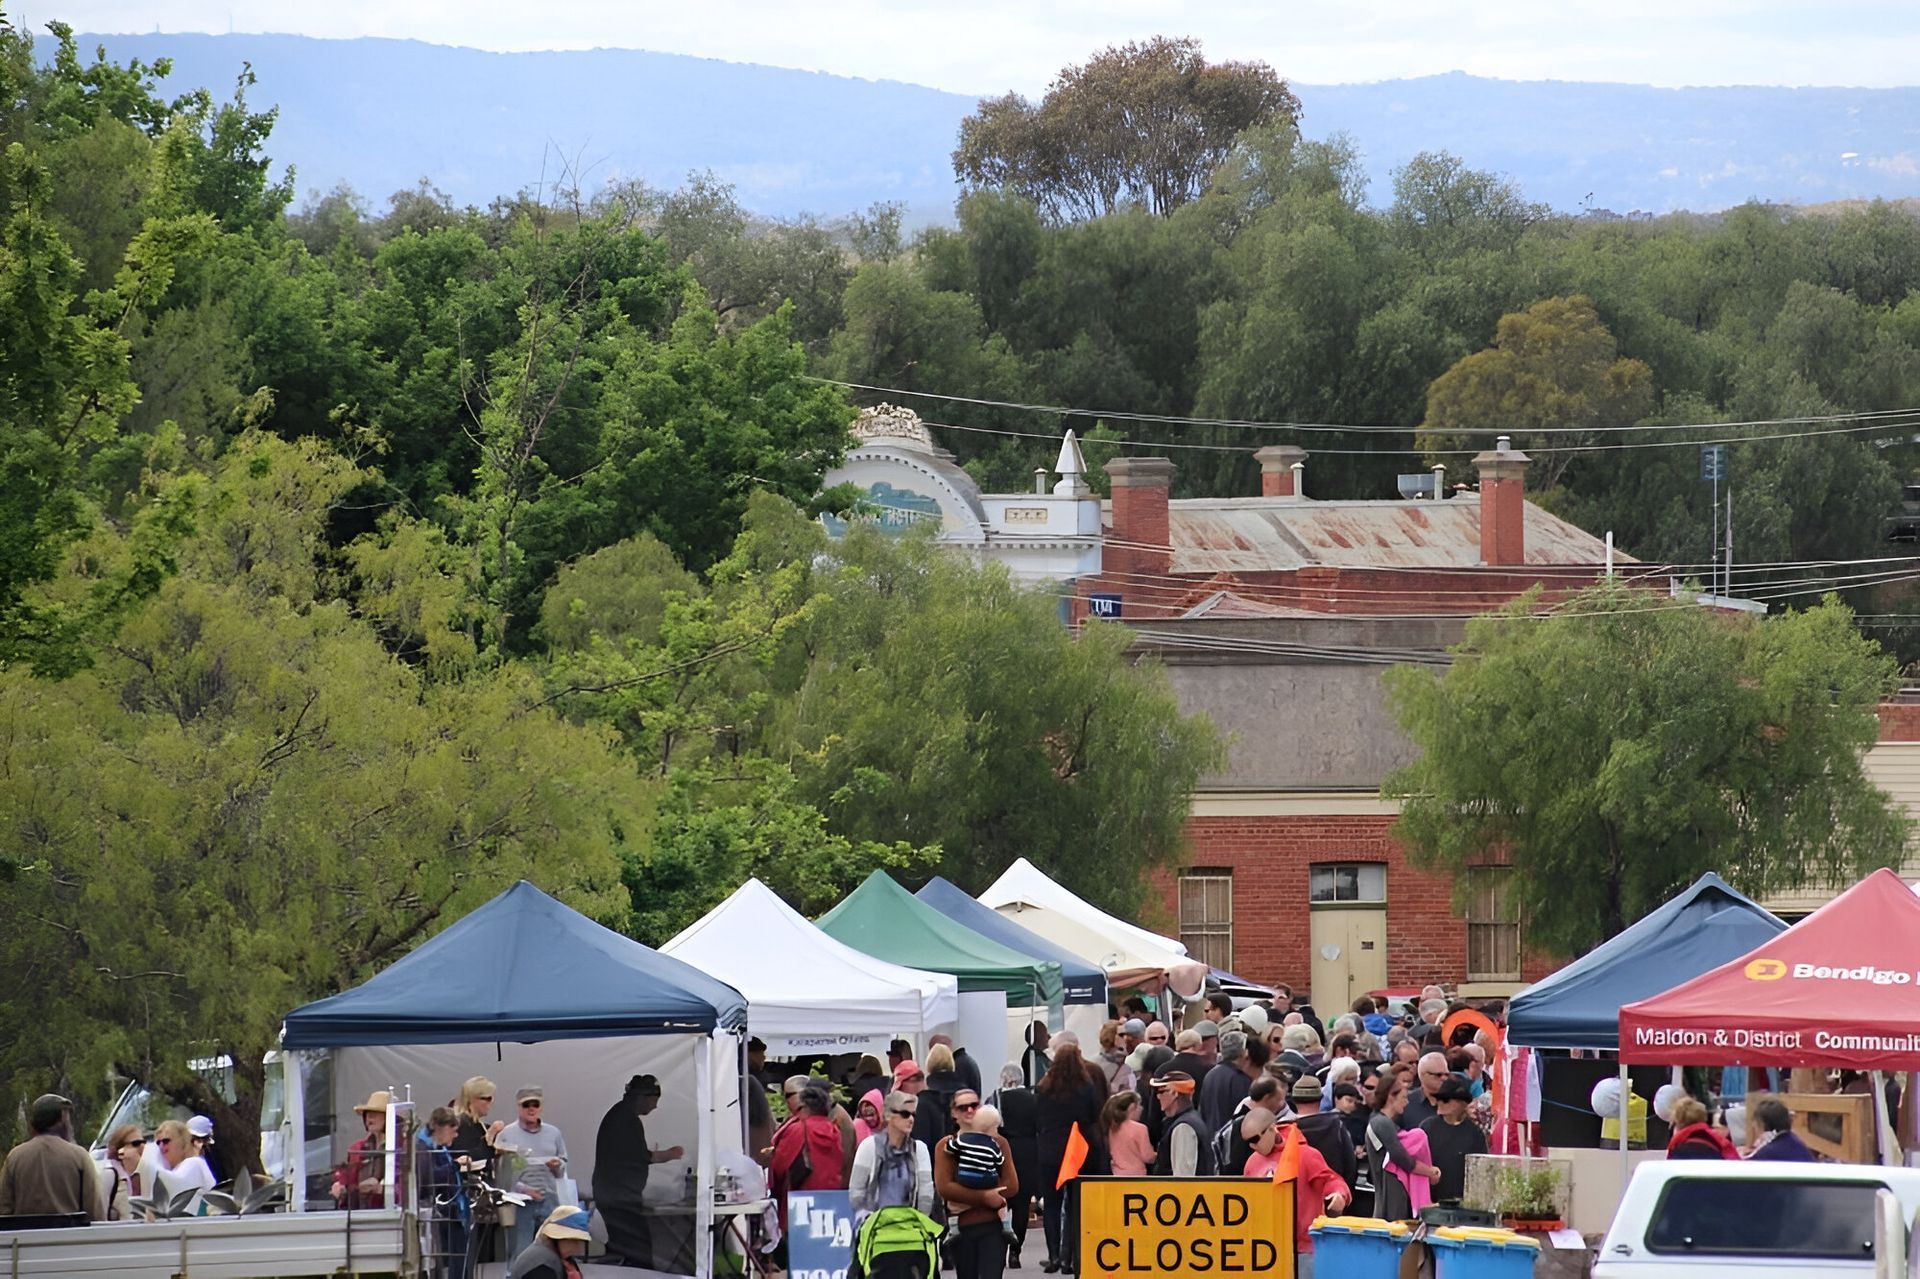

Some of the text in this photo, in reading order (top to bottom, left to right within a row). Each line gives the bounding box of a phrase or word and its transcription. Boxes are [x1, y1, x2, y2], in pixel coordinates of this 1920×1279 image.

[1793, 963, 1911, 985] Bendigo
[1636, 1027, 1708, 1046] Maldon
[1713, 1029, 1729, 1047] &
[1734, 1029, 1803, 1049] District
[1123, 1193, 1249, 1227] ROAD
[1096, 1238, 1277, 1272] CLOSED
